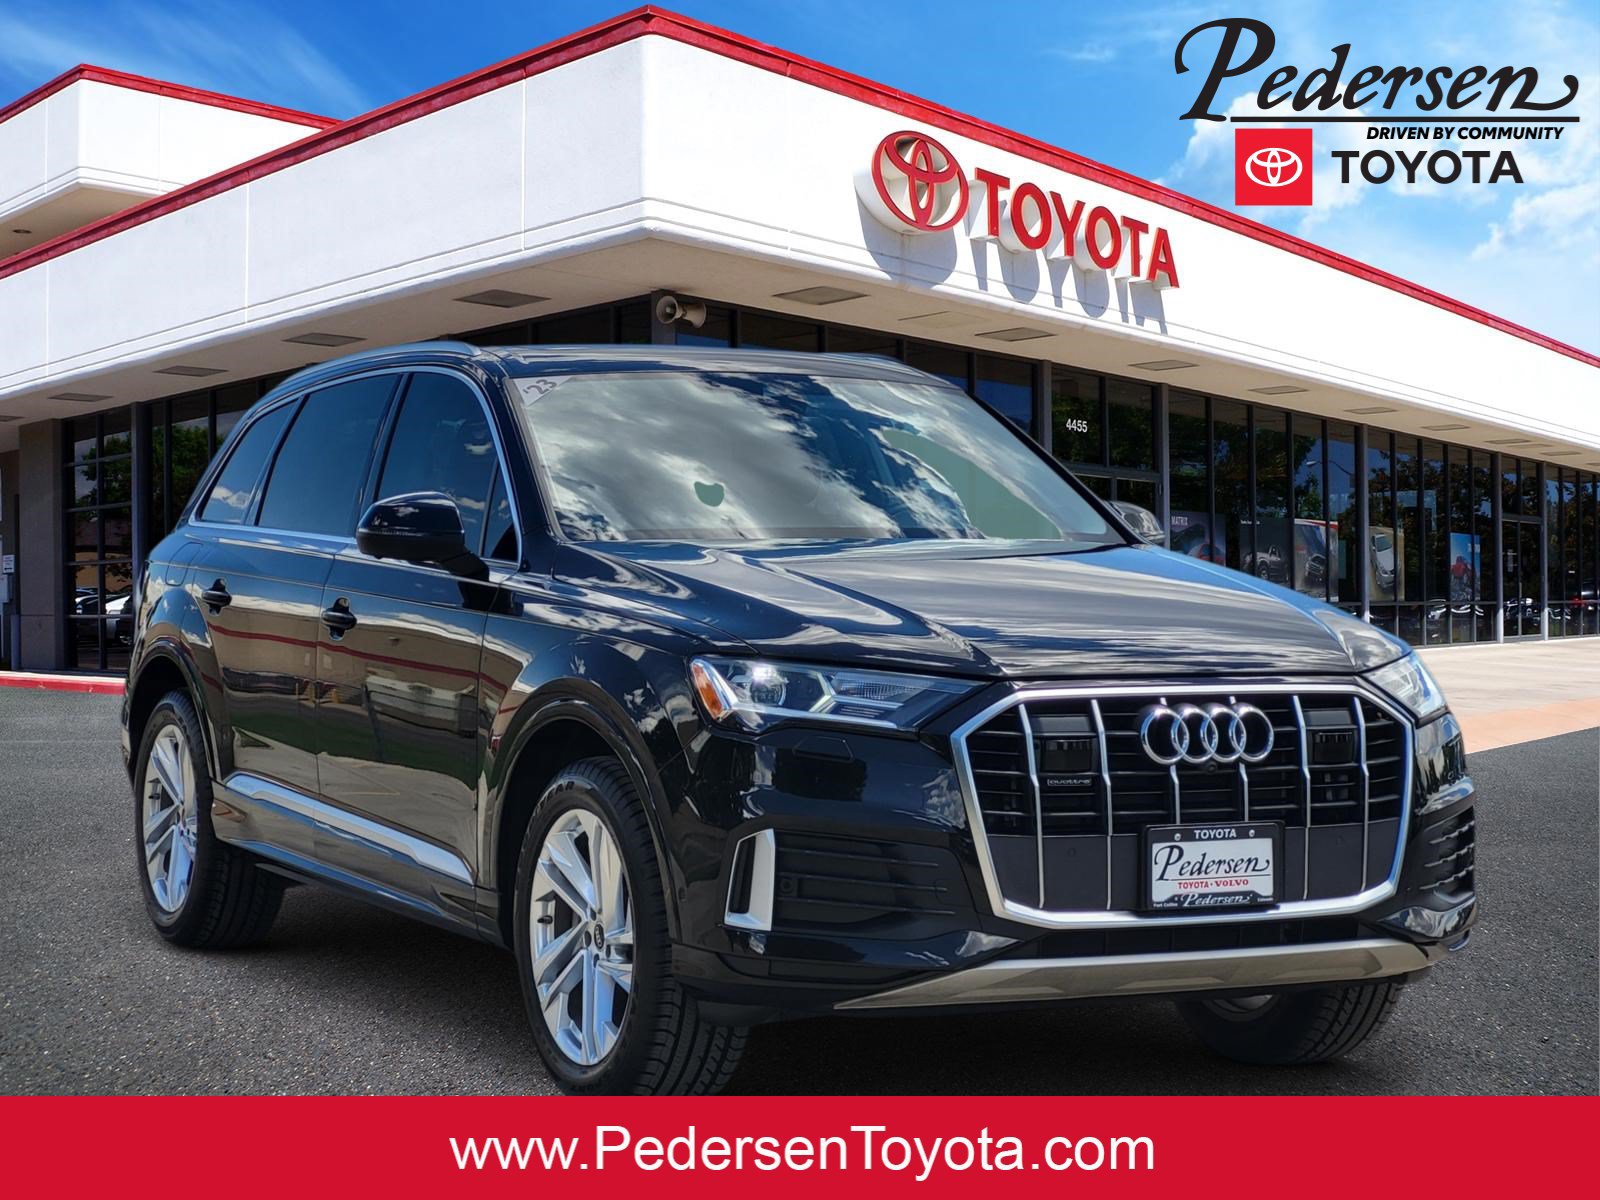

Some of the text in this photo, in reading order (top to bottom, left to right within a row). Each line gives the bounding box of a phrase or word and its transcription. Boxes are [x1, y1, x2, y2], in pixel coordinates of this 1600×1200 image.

[975, 167, 1179, 288] TOYOTA
[1066, 418, 1088, 433] 4455
[1194, 829, 1237, 839] TOYOTA
[1154, 845, 1270, 881] Pedersen
[1178, 879, 1249, 889] TOYOTA VOLVO
[1181, 893, 1252, 907] Pedersen
